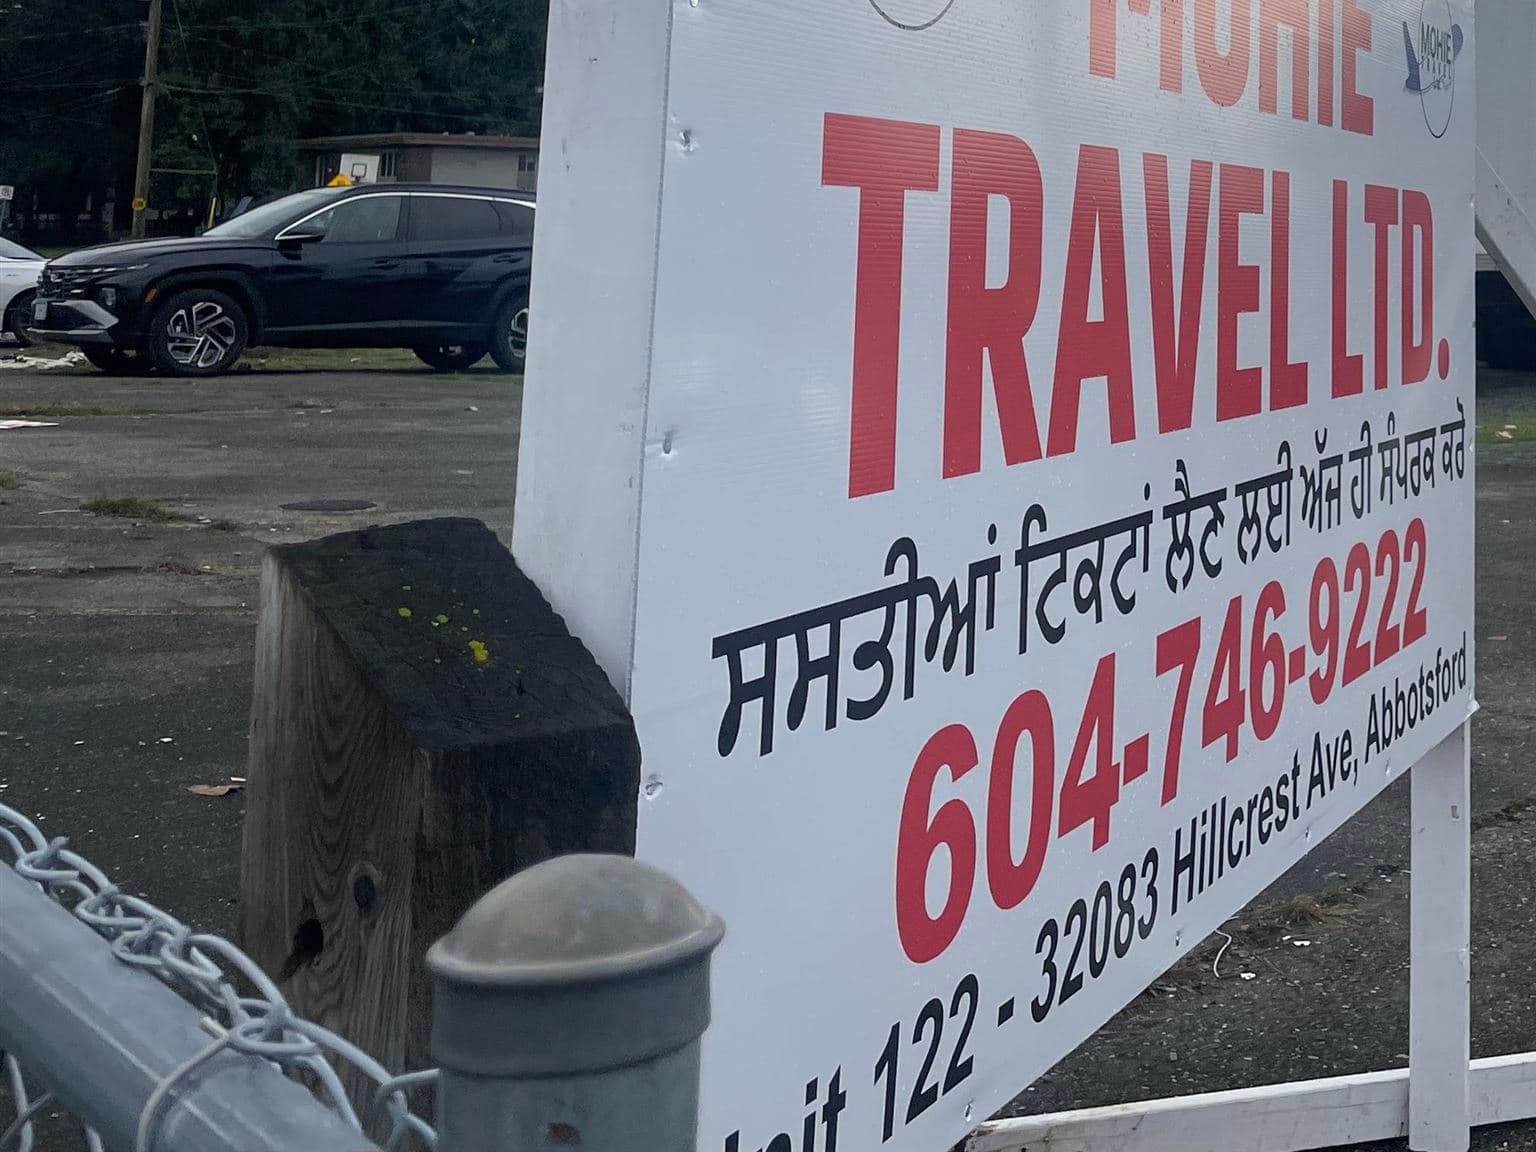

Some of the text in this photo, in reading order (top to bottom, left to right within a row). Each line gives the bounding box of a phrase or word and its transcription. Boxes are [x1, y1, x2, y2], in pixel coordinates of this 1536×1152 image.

[1421, 21, 1452, 64] MOHIE
[821, 113, 1451, 500] TRAVEL LTD.
[712, 523, 1001, 757] ਸਸਤੀਆਂ
[1014, 482, 1153, 655] ਟਿਕਟਾਂ
[1163, 459, 1227, 593] ਲੈਣ
[1235, 441, 1294, 565] ਲਈ
[1300, 427, 1344, 533] ਅੱਜ
[1349, 420, 1373, 519] ਹੀ
[1378, 411, 1437, 505] ਸੰਪਰਕ
[896, 517, 1428, 963] 604-746-9222
[873, 973, 979, 1144] 122
[997, 997, 1015, 1027] -
[1030, 847, 1160, 1023] 32083
[1171, 748, 1301, 916] Hillcrest
[1306, 729, 1358, 810] Ave,
[1364, 631, 1466, 764] Abbotsford
